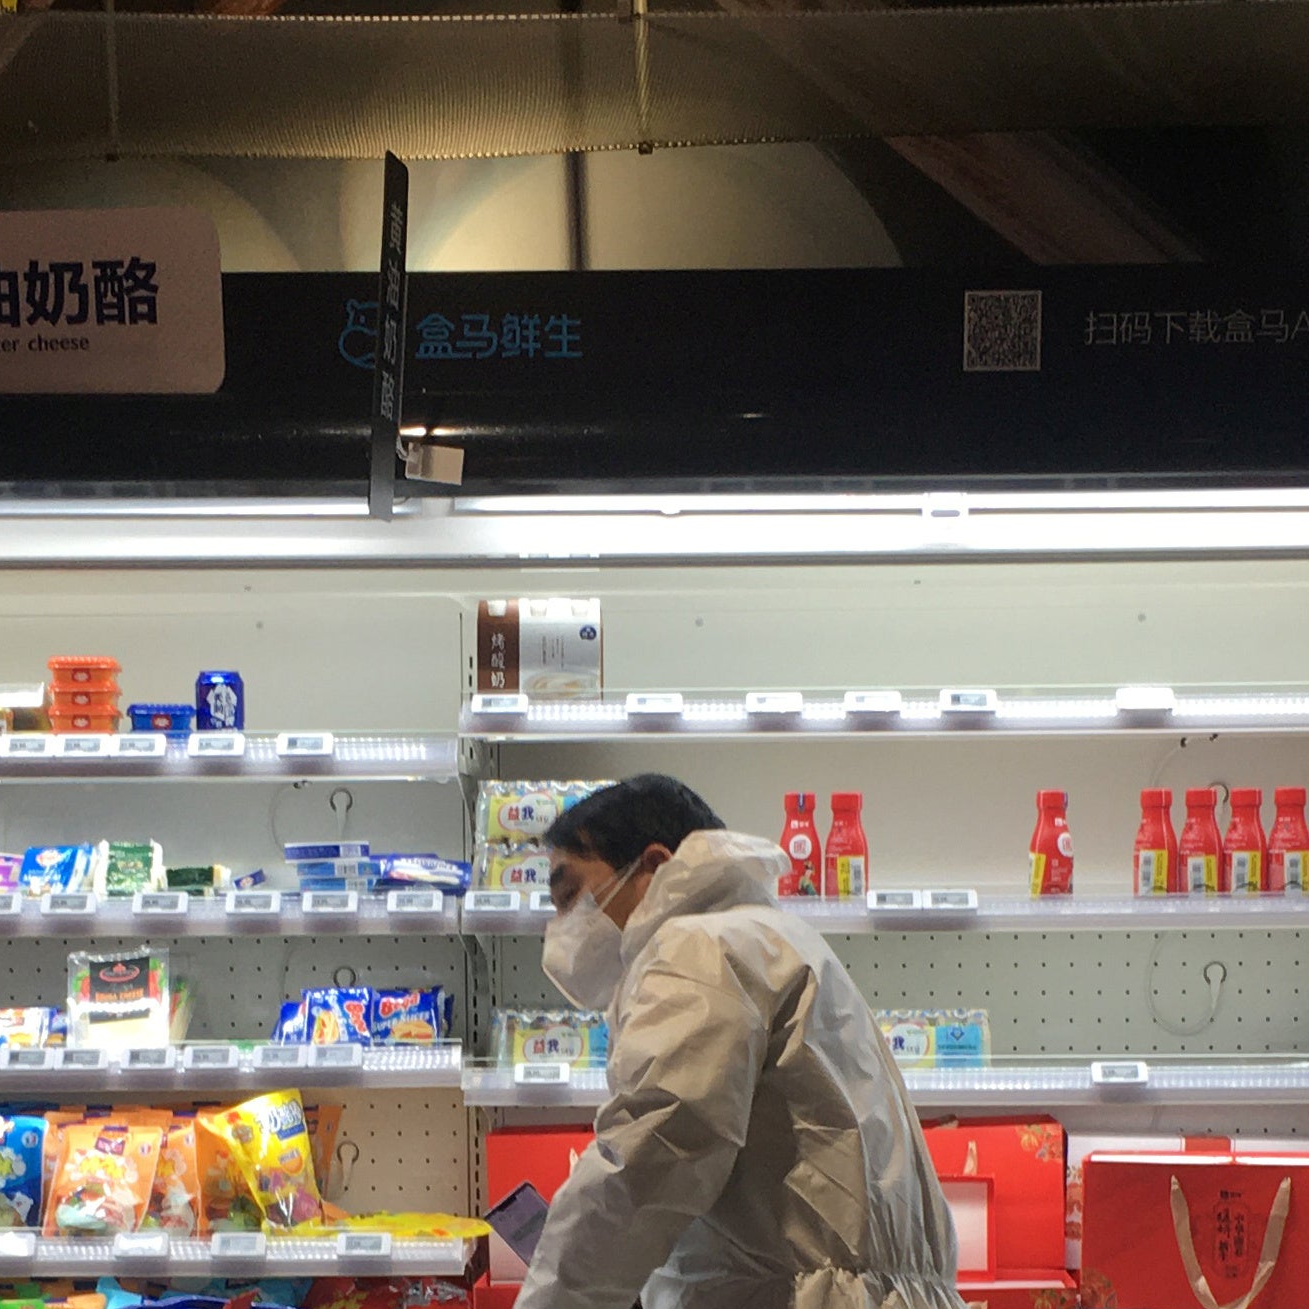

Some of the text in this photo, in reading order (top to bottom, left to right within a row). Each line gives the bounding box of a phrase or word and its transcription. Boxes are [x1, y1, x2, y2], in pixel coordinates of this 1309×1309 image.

[27, 335, 90, 353] cheese
[415, 313, 584, 360] 盒马鲜生
